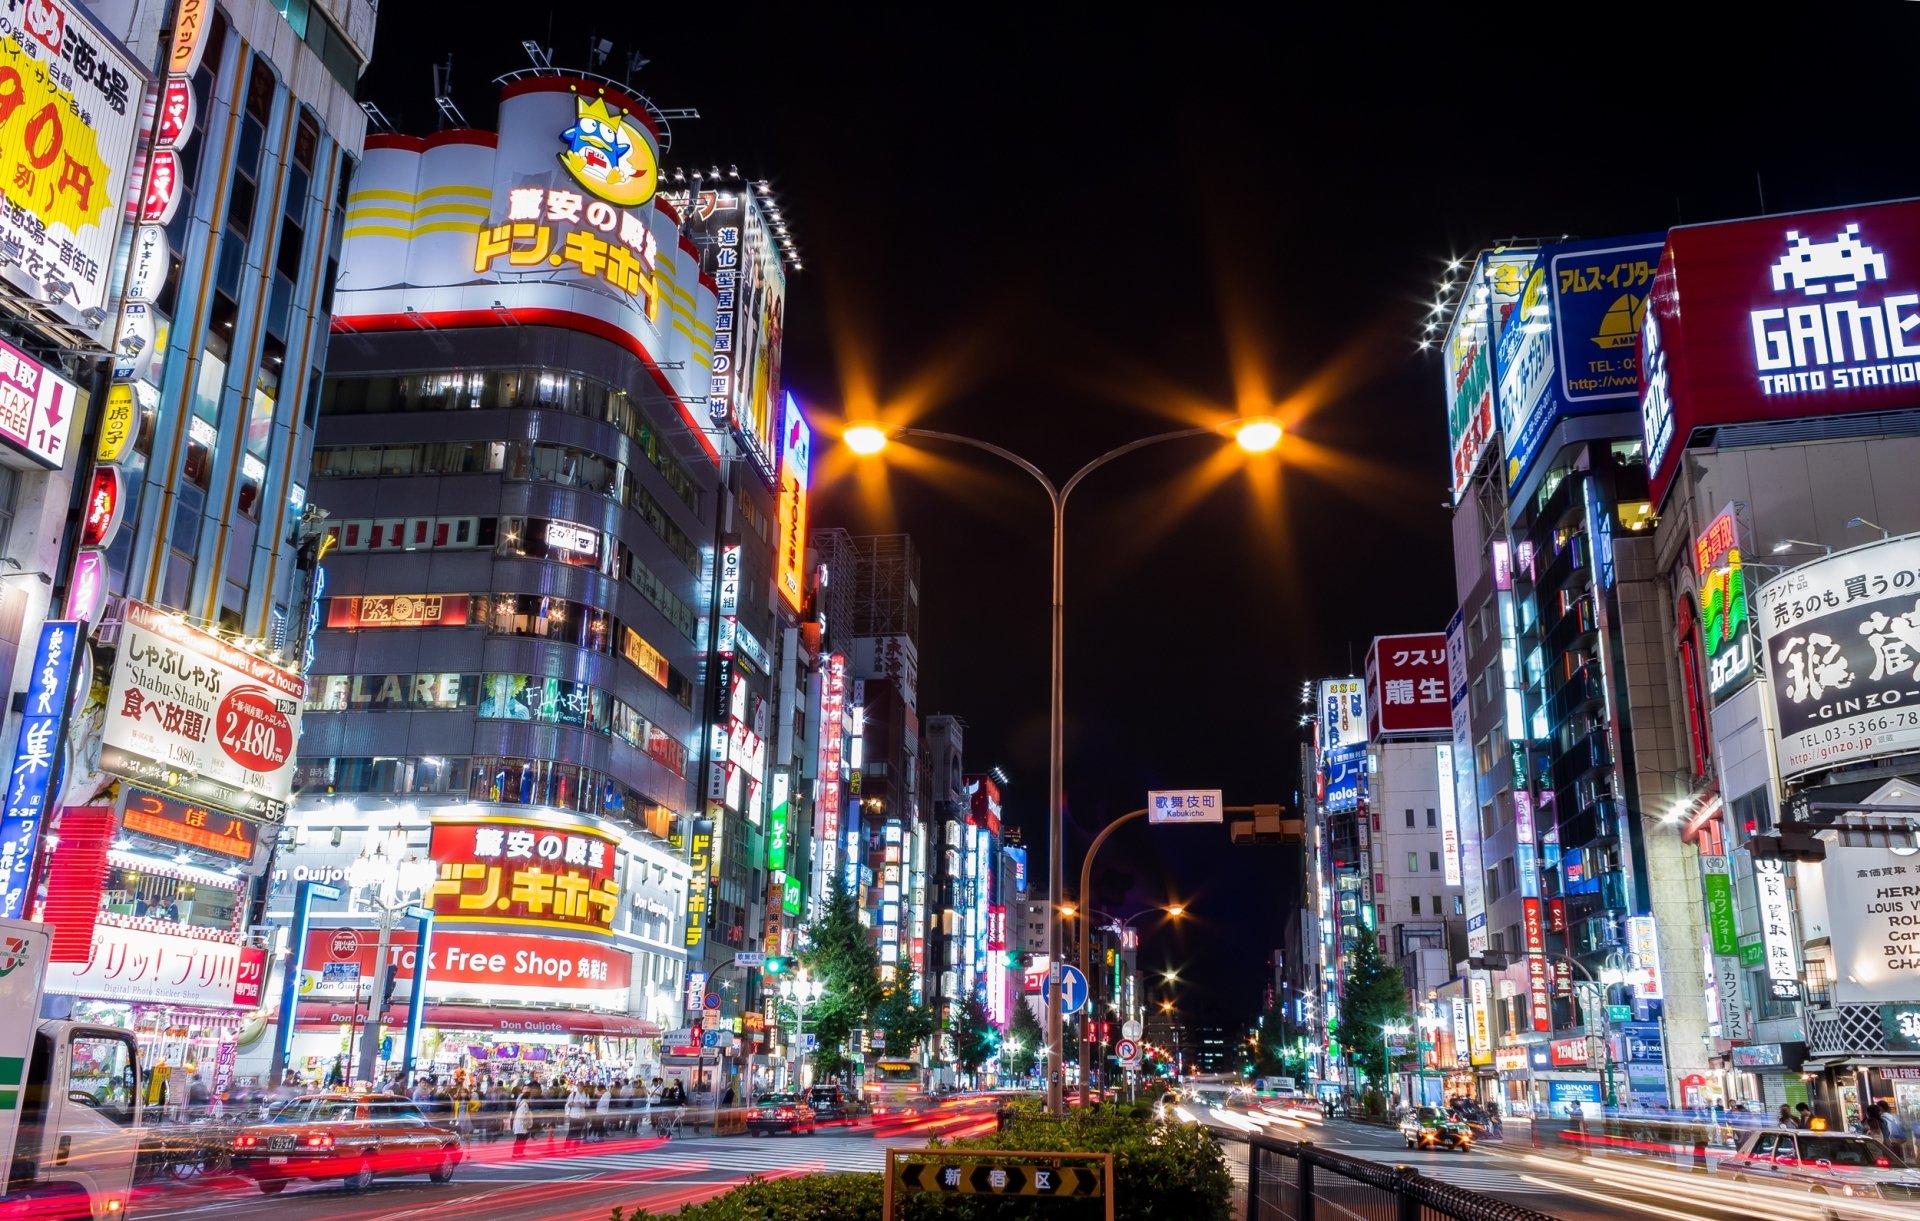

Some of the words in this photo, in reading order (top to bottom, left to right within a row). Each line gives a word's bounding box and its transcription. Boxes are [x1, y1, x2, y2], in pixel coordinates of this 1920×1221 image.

[61, 24, 129, 116] 酒場
[1751, 294, 1920, 371] GAME
[117, 369, 130, 377] 5F
[1760, 371, 1827, 395] TAITO
[3, 386, 30, 417] TAX
[0, 404, 27, 436] FREE
[105, 407, 129, 445] 虎の子
[36, 429, 61, 455] 1F
[100, 450, 114, 458] 4F
[722, 552, 737, 609] 6年4組
[1761, 574, 1809, 608] ブランド品
[1773, 587, 1840, 629] 売るのも
[129, 633, 223, 694] しゃぶしゃぶ
[131, 607, 147, 624] All
[276, 674, 303, 697] hours
[1392, 649, 1446, 667] クスリ
[324, 673, 462, 703] FLARE
[1385, 677, 1447, 705] 龍生
[120, 686, 212, 744] 食べ放題!
[15, 718, 54, 774] 集
[222, 711, 276, 763] 2,480
[272, 752, 284, 764] yen
[1789, 736, 1873, 767] http://ginzo.jp
[1155, 795, 1216, 809] 歌舞伎町
[1166, 809, 1205, 818] Kabukicho
[141, 797, 244, 841] つぼ八
[14, 820, 34, 872] ワインと
[474, 828, 605, 870] 驚安の殿堂
[773, 819, 784, 850] レイク
[1856, 865, 1907, 879] 高価買取
[785, 883, 799, 906] レイク
[1867, 902, 1904, 914] LOUIS
[1713, 888, 1732, 954] カワノ・クォーク
[239, 961, 261, 980] プリ
[445, 946, 506, 974] Free
[513, 950, 573, 983] Shop
[576, 955, 609, 983] 免税店
[103, 982, 131, 994] Digital
[132, 984, 154, 996] Photo
[155, 986, 181, 998] Sticker
[182, 989, 201, 1000] Shop
[235, 981, 258, 997] 専門店
[315, 981, 334, 992] Don
[330, 1013, 351, 1025] Don
[1723, 971, 1743, 1039] カワノ・トラスト
[500, 1019, 520, 1031] Don
[521, 1020, 563, 1034] Quijote
[1555, 1084, 1594, 1092] SUBNADE
[1882, 1068, 1899, 1079] TAX
[1900, 1068, 1920, 1079] FREE
[944, 1167, 1051, 1189] 新宿区
